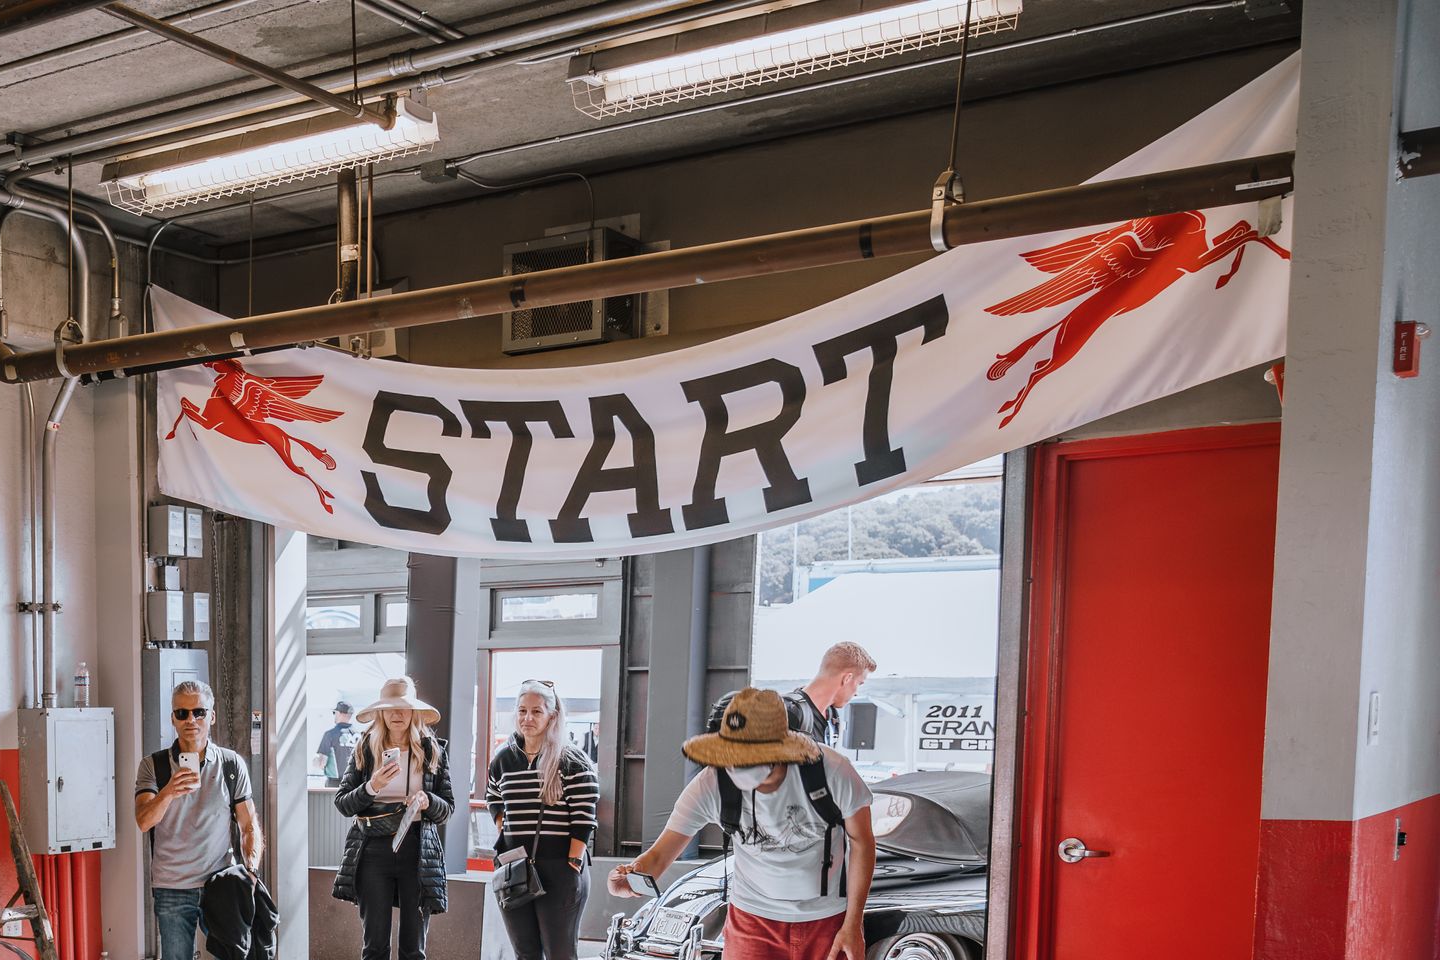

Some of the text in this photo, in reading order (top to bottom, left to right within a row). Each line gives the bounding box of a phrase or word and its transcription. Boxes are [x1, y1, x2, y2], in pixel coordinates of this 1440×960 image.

[1399, 332, 1408, 361] FIRE
[360, 294, 949, 543] START
[925, 705, 983, 719] 2011
[921, 721, 995, 736] GRAN
[922, 739, 995, 750] GT CH
